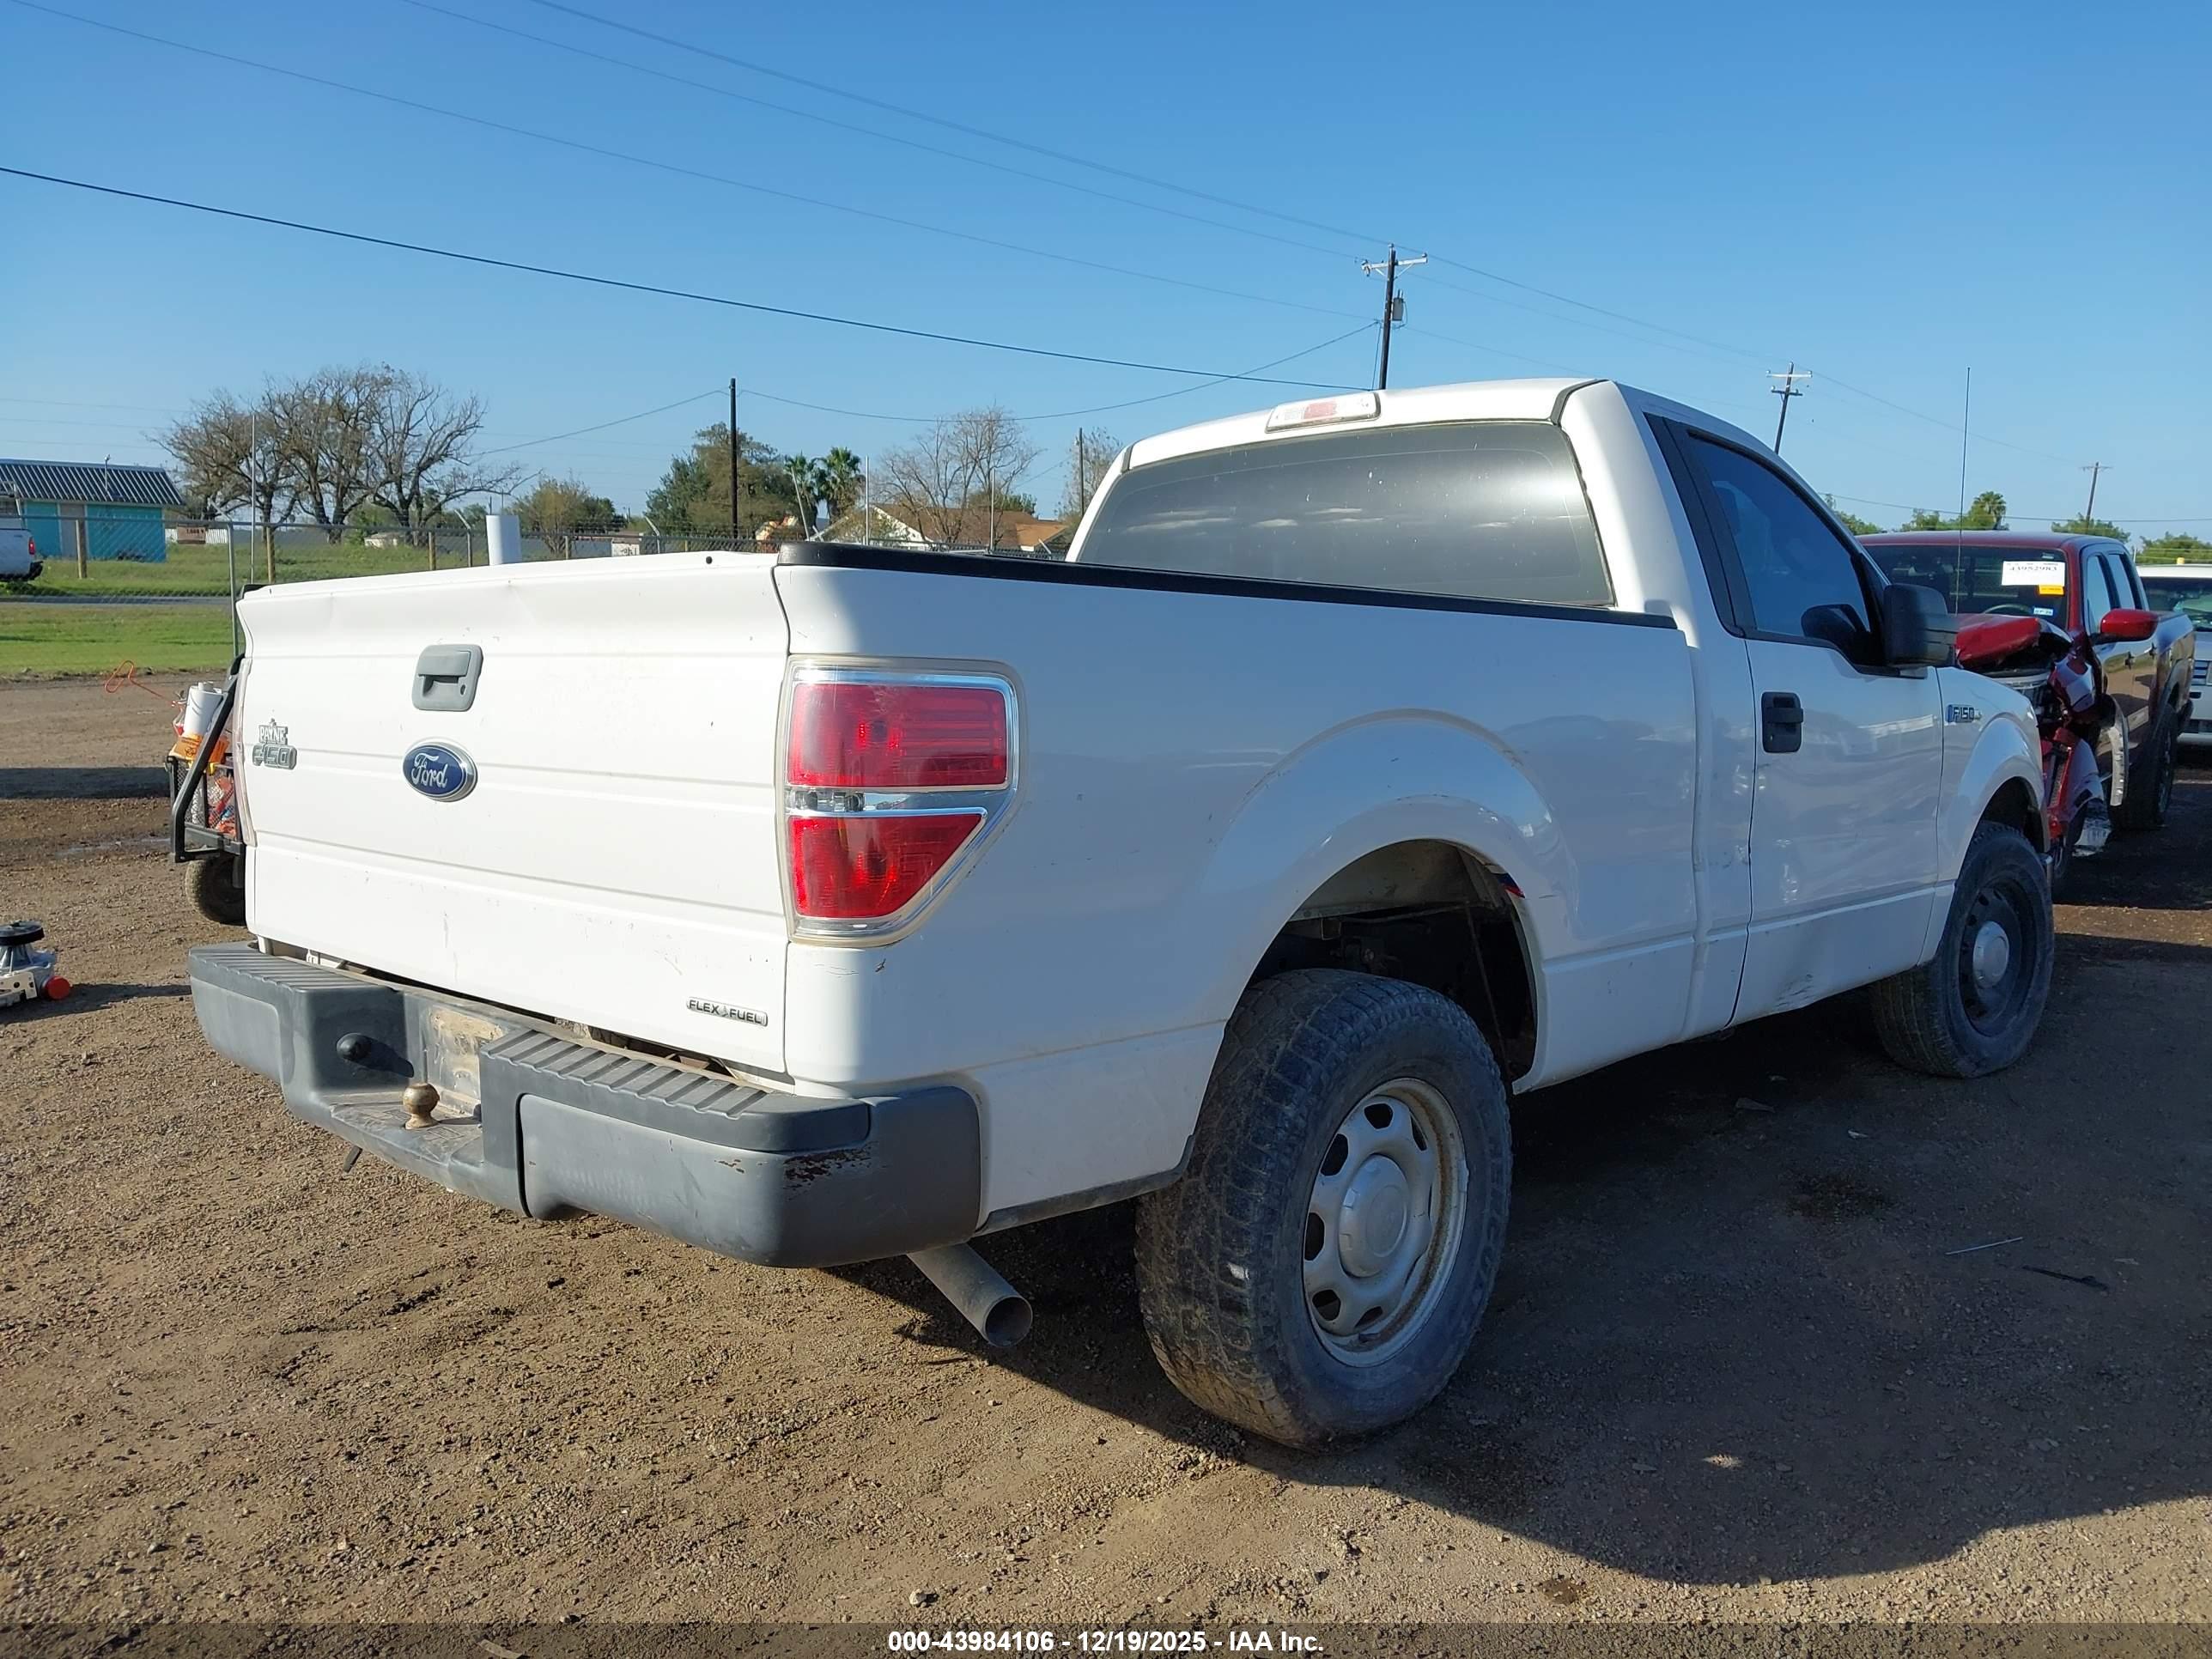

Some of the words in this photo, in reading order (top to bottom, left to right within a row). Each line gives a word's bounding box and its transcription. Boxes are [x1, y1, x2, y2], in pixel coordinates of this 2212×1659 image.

[258, 726, 288, 744] PAYNE
[411, 753, 448, 788] Ford
[689, 1000, 720, 1016] FLEX
[729, 1008, 762, 1024] FUEL
